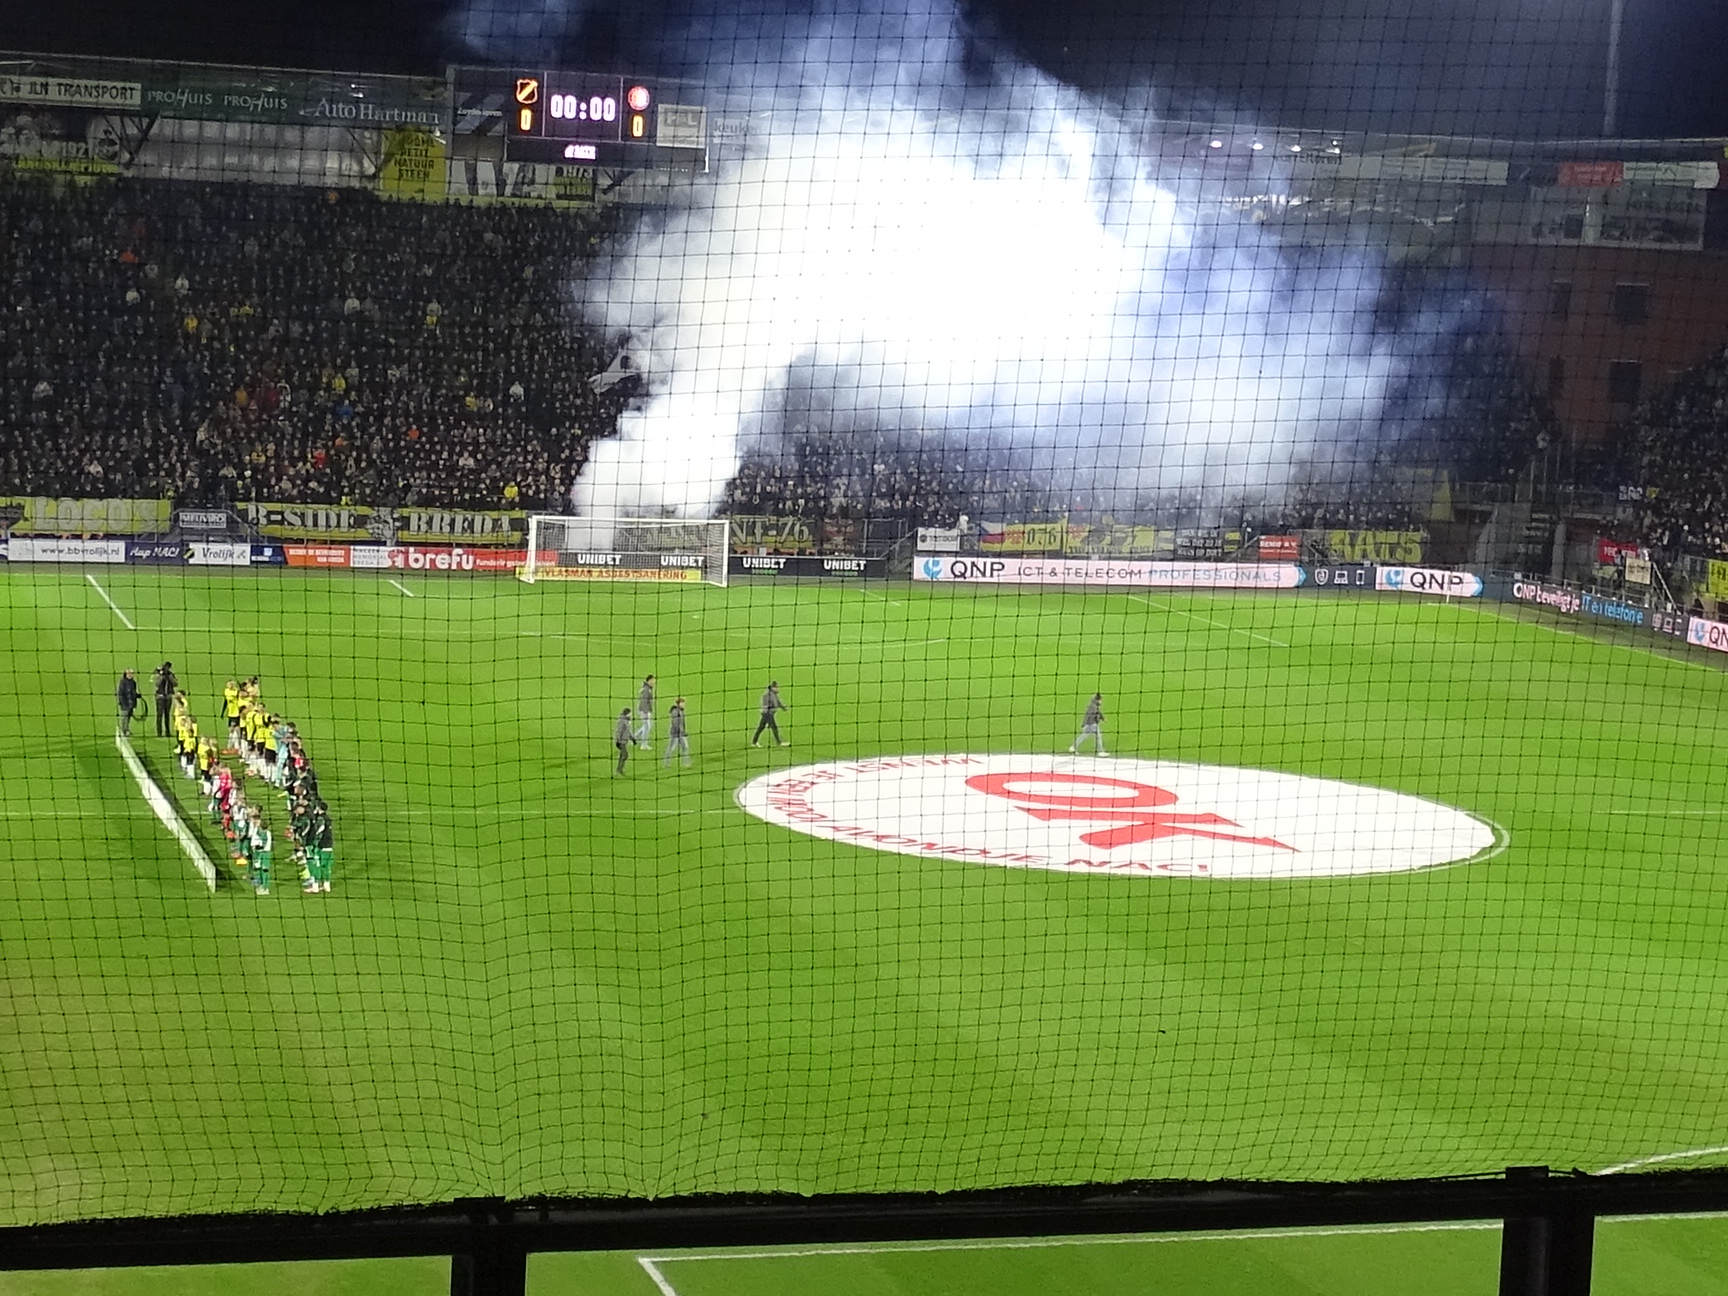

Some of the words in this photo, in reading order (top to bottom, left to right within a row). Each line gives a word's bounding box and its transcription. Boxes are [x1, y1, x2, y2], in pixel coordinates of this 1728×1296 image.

[56, 82, 136, 101] TRANSPORT
[314, 97, 356, 118] Auto
[550, 94, 616, 122] 00:00
[519, 108, 532, 131] 0
[632, 114, 643, 138] 0
[247, 504, 357, 533] B-SIDE
[409, 511, 512, 536] BREDA
[202, 548, 234, 560] Vrolijk
[408, 549, 473, 571] brefu
[577, 554, 621, 566] UNIBET
[661, 556, 704, 567] UNIBET
[743, 556, 786, 569] UNIBET
[824, 559, 866, 571] UNIBET
[950, 560, 1006, 579] QNP
[1018, 567, 1042, 577] ICT
[1049, 568, 1058, 578] &
[1064, 568, 1142, 580] TELECOM
[1147, 569, 1282, 583] PROFESSIONALS
[1410, 571, 1464, 591] QNP
[1513, 581, 1536, 601] QNP
[1536, 585, 1571, 612] beveiligt
[1581, 592, 1591, 611] IT
[1592, 598, 1603, 614] en
[1605, 599, 1643, 624] telefonie
[964, 772, 1302, 852] OK
[816, 824, 1051, 864] AVONDJE
[1063, 857, 1209, 873] NAC!
